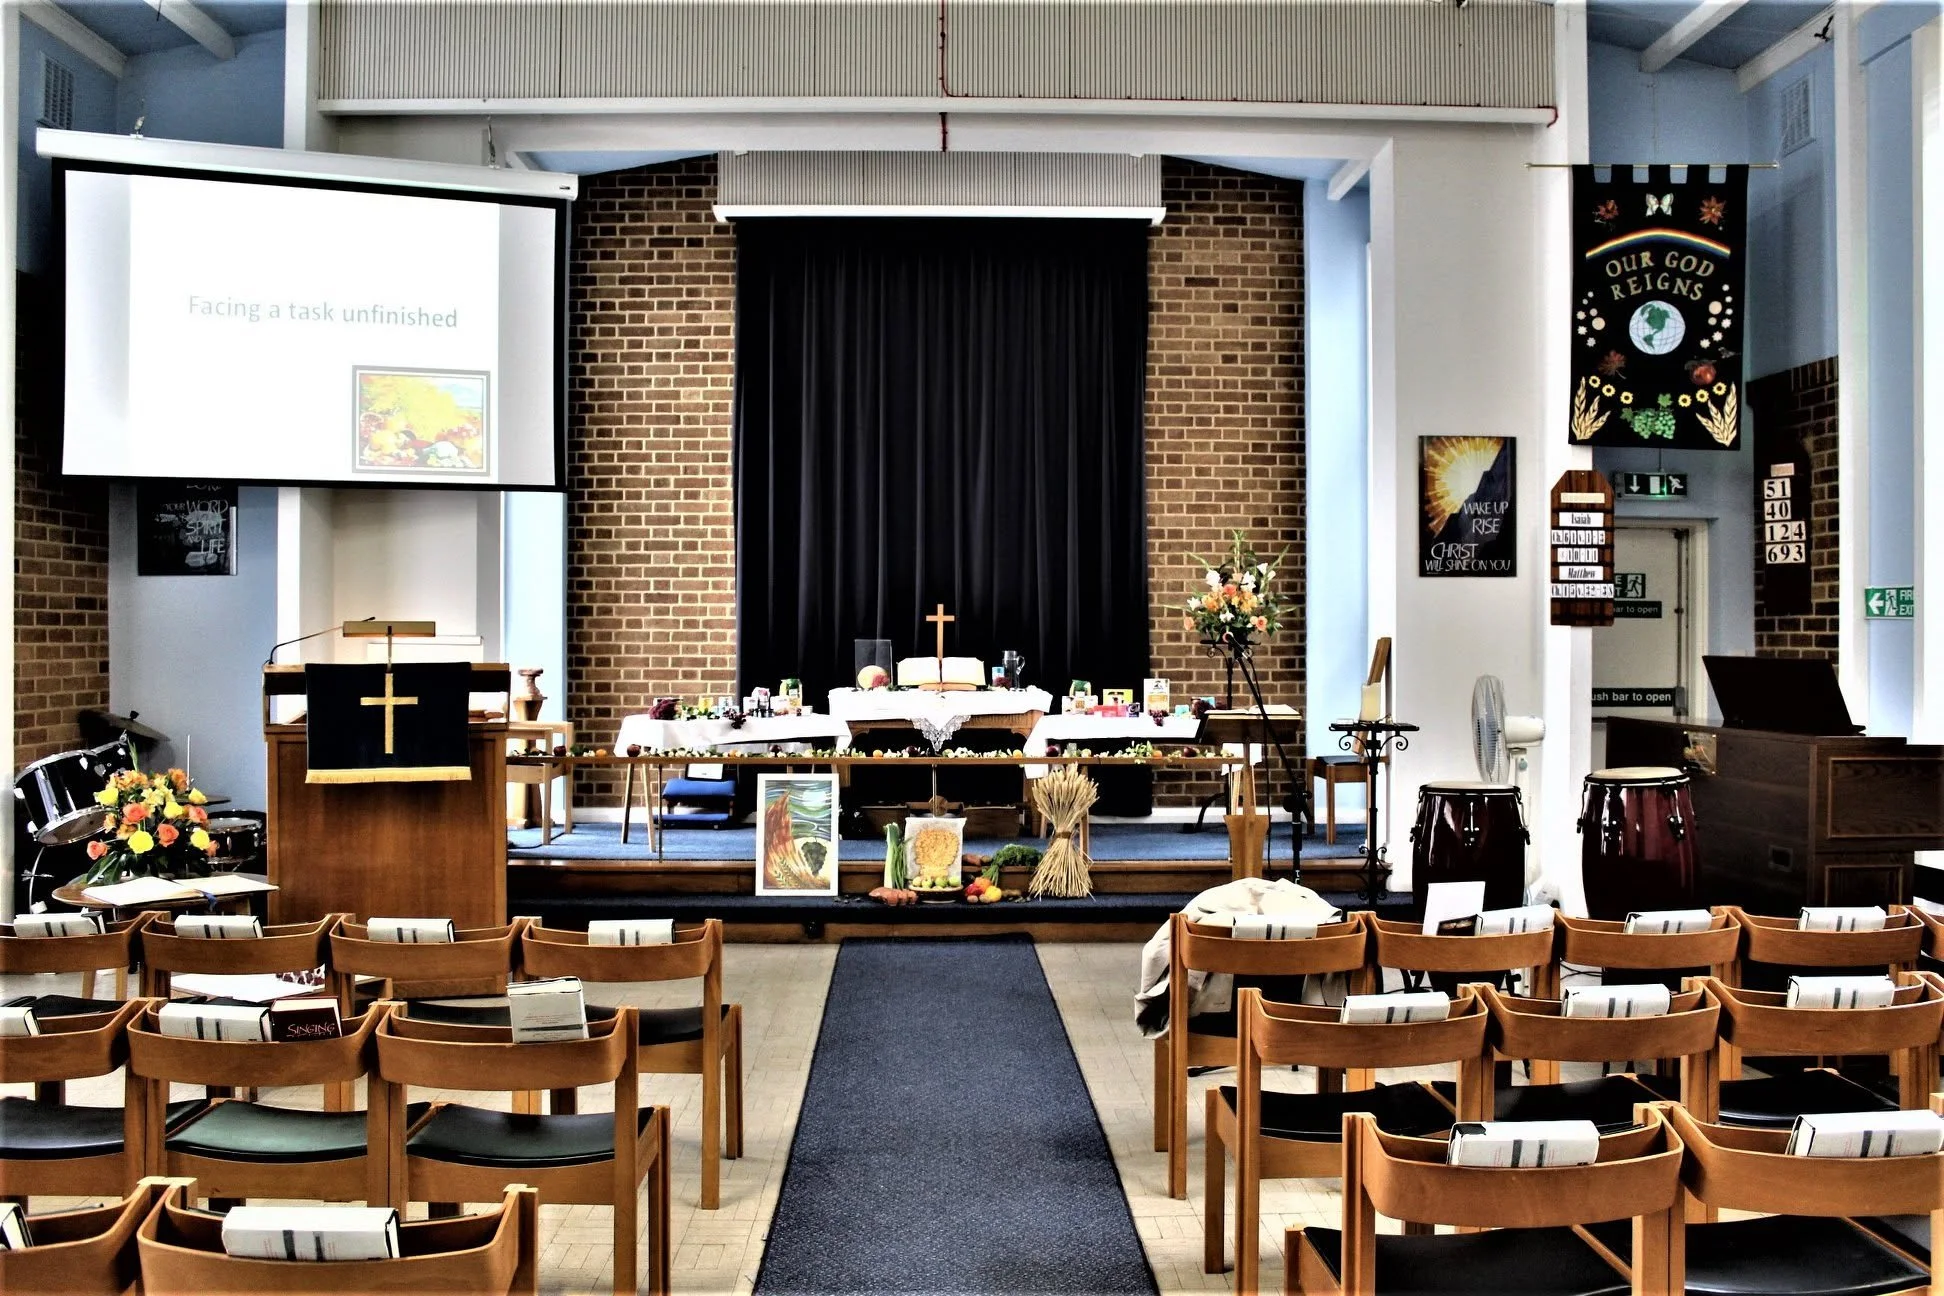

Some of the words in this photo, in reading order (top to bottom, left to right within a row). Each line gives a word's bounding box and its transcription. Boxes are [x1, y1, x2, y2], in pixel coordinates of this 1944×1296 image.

[1605, 250, 1655, 277] OUR
[1664, 250, 1715, 277] GOD
[1610, 272, 1704, 300] REIGNS
[188, 295, 261, 323] Facing
[268, 303, 280, 319] a
[288, 301, 335, 322] task
[342, 304, 458, 328] unfinished
[1765, 480, 1787, 498] 51
[186, 499, 229, 514] WORD
[1463, 501, 1491, 515] WAKE
[1493, 501, 1509, 515] UP
[1765, 501, 1789, 519] 40
[185, 519, 226, 535] SPIRIT
[1472, 518, 1500, 535] RISE
[1570, 513, 1591, 525] Isaiah
[1767, 522, 1804, 541] 124
[200, 538, 226, 554] LIFE
[1430, 541, 1479, 560] CHRIST
[1767, 544, 1803, 563] 693
[1424, 559, 1444, 571] WILL
[1444, 559, 1470, 572] SHINE
[1471, 559, 1488, 571] ON
[1489, 559, 1511, 571] YOU
[1567, 567, 1596, 579] Matthew
[1899, 589, 1913, 601] FIR
[1626, 605, 1635, 613] to
[1612, 691, 1629, 701] bar
[1632, 692, 1643, 701] to
[1645, 693, 1672, 704] open
[287, 1021, 335, 1036] SINGING
